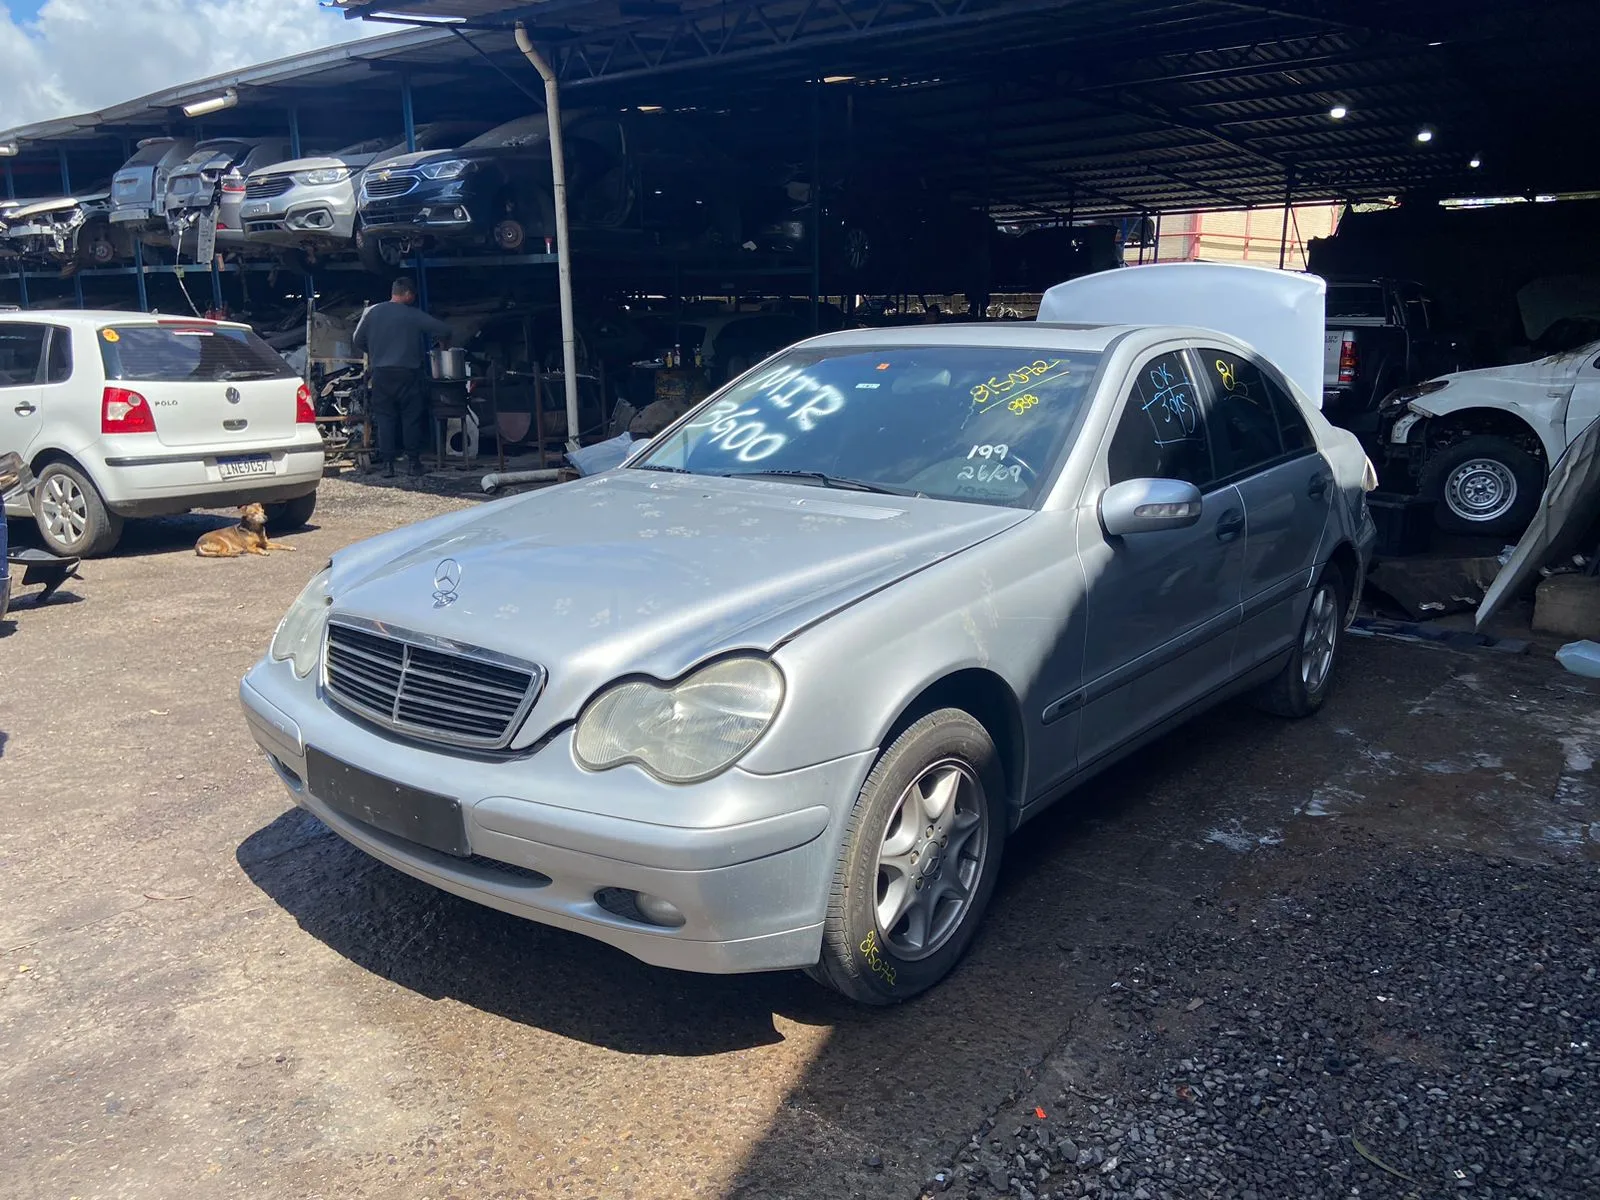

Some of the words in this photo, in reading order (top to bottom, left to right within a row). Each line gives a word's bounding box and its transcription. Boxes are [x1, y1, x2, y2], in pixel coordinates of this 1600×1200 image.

[1150, 362, 1175, 389] OK
[739, 365, 844, 431] MIR
[966, 444, 1009, 460] 199
[957, 464, 1022, 482] 26/09
